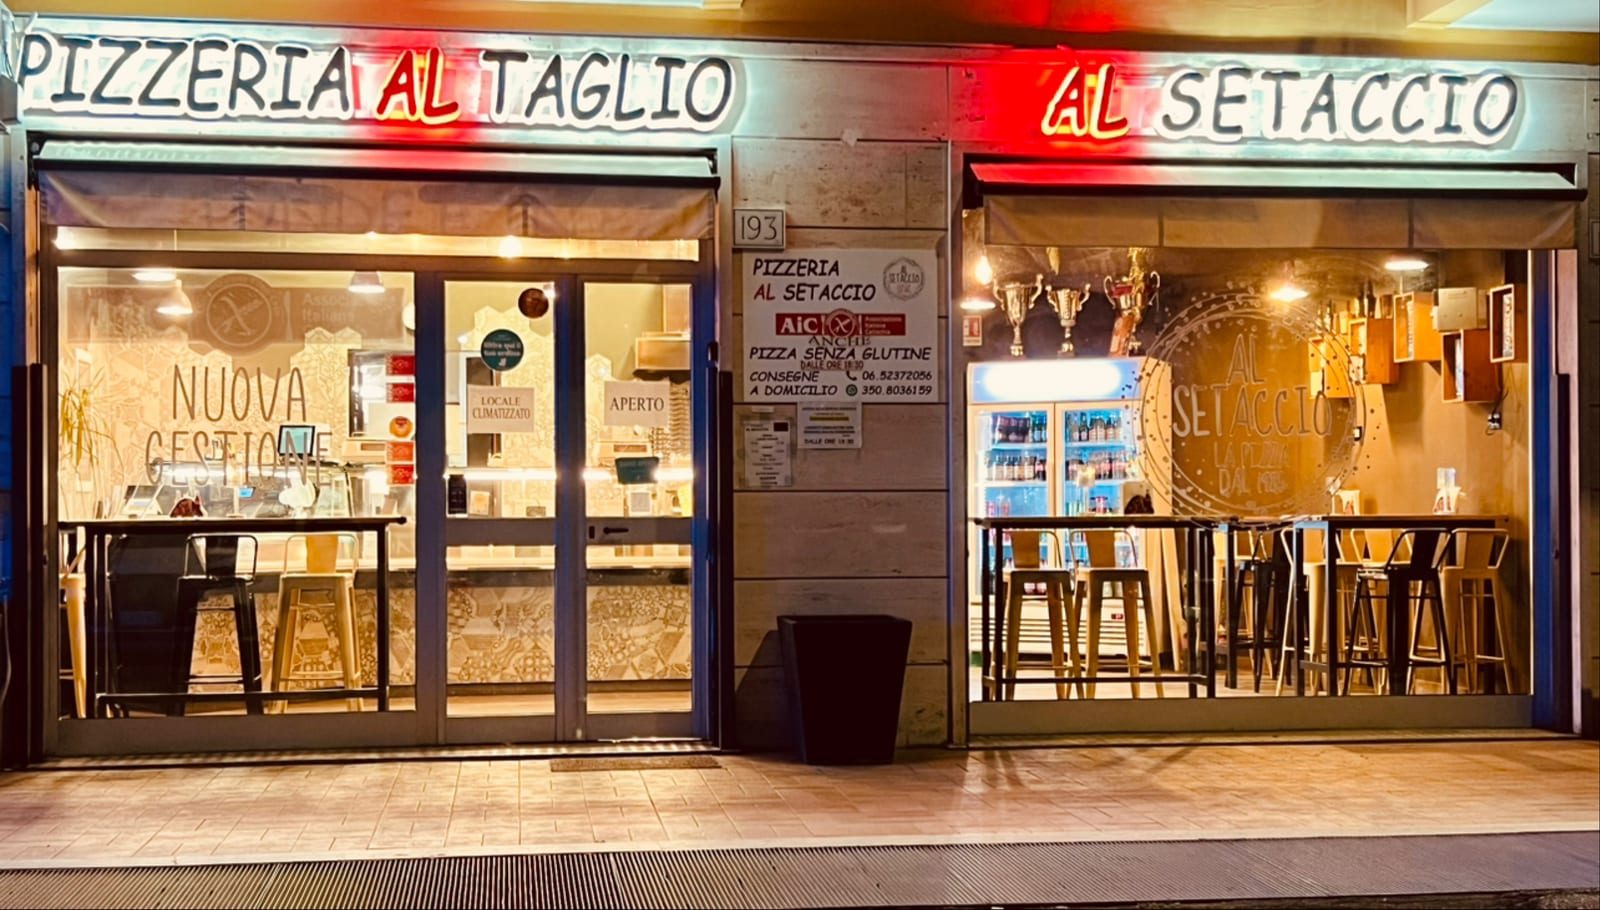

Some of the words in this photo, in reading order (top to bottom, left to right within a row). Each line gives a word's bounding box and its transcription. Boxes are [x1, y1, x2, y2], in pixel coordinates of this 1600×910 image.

[19, 33, 352, 118] PIZZERIA
[376, 47, 460, 124] AL
[481, 49, 733, 127] TAGLIO
[1042, 65, 1130, 139] AL
[1160, 67, 1518, 138] SETACCIO
[741, 215, 777, 241] 193
[753, 258, 840, 277] PIZZERIA
[753, 284, 775, 301] AL
[783, 283, 876, 301] SETACCIO
[780, 316, 819, 334] AiC
[808, 335, 871, 347] ANCHE
[750, 347, 797, 360] PIZZA
[803, 347, 855, 360] SENZA
[862, 347, 932, 361] GLUTINE
[1226, 334, 1265, 385] AL
[801, 360, 824, 369] DALLE
[827, 360, 843, 369] ORE
[750, 371, 820, 382] CONSEGNE
[862, 371, 932, 381] 06.52372056
[172, 364, 307, 422] NUOVA
[750, 385, 759, 395] A
[765, 385, 838, 396] DOMICILIO
[481, 396, 521, 406] LOCALE
[609, 396, 665, 412] APERTO
[472, 406, 531, 420] CLIMATIZZATO
[1172, 384, 1332, 438] SETACCIO
[145, 430, 333, 487] GESTIONE
